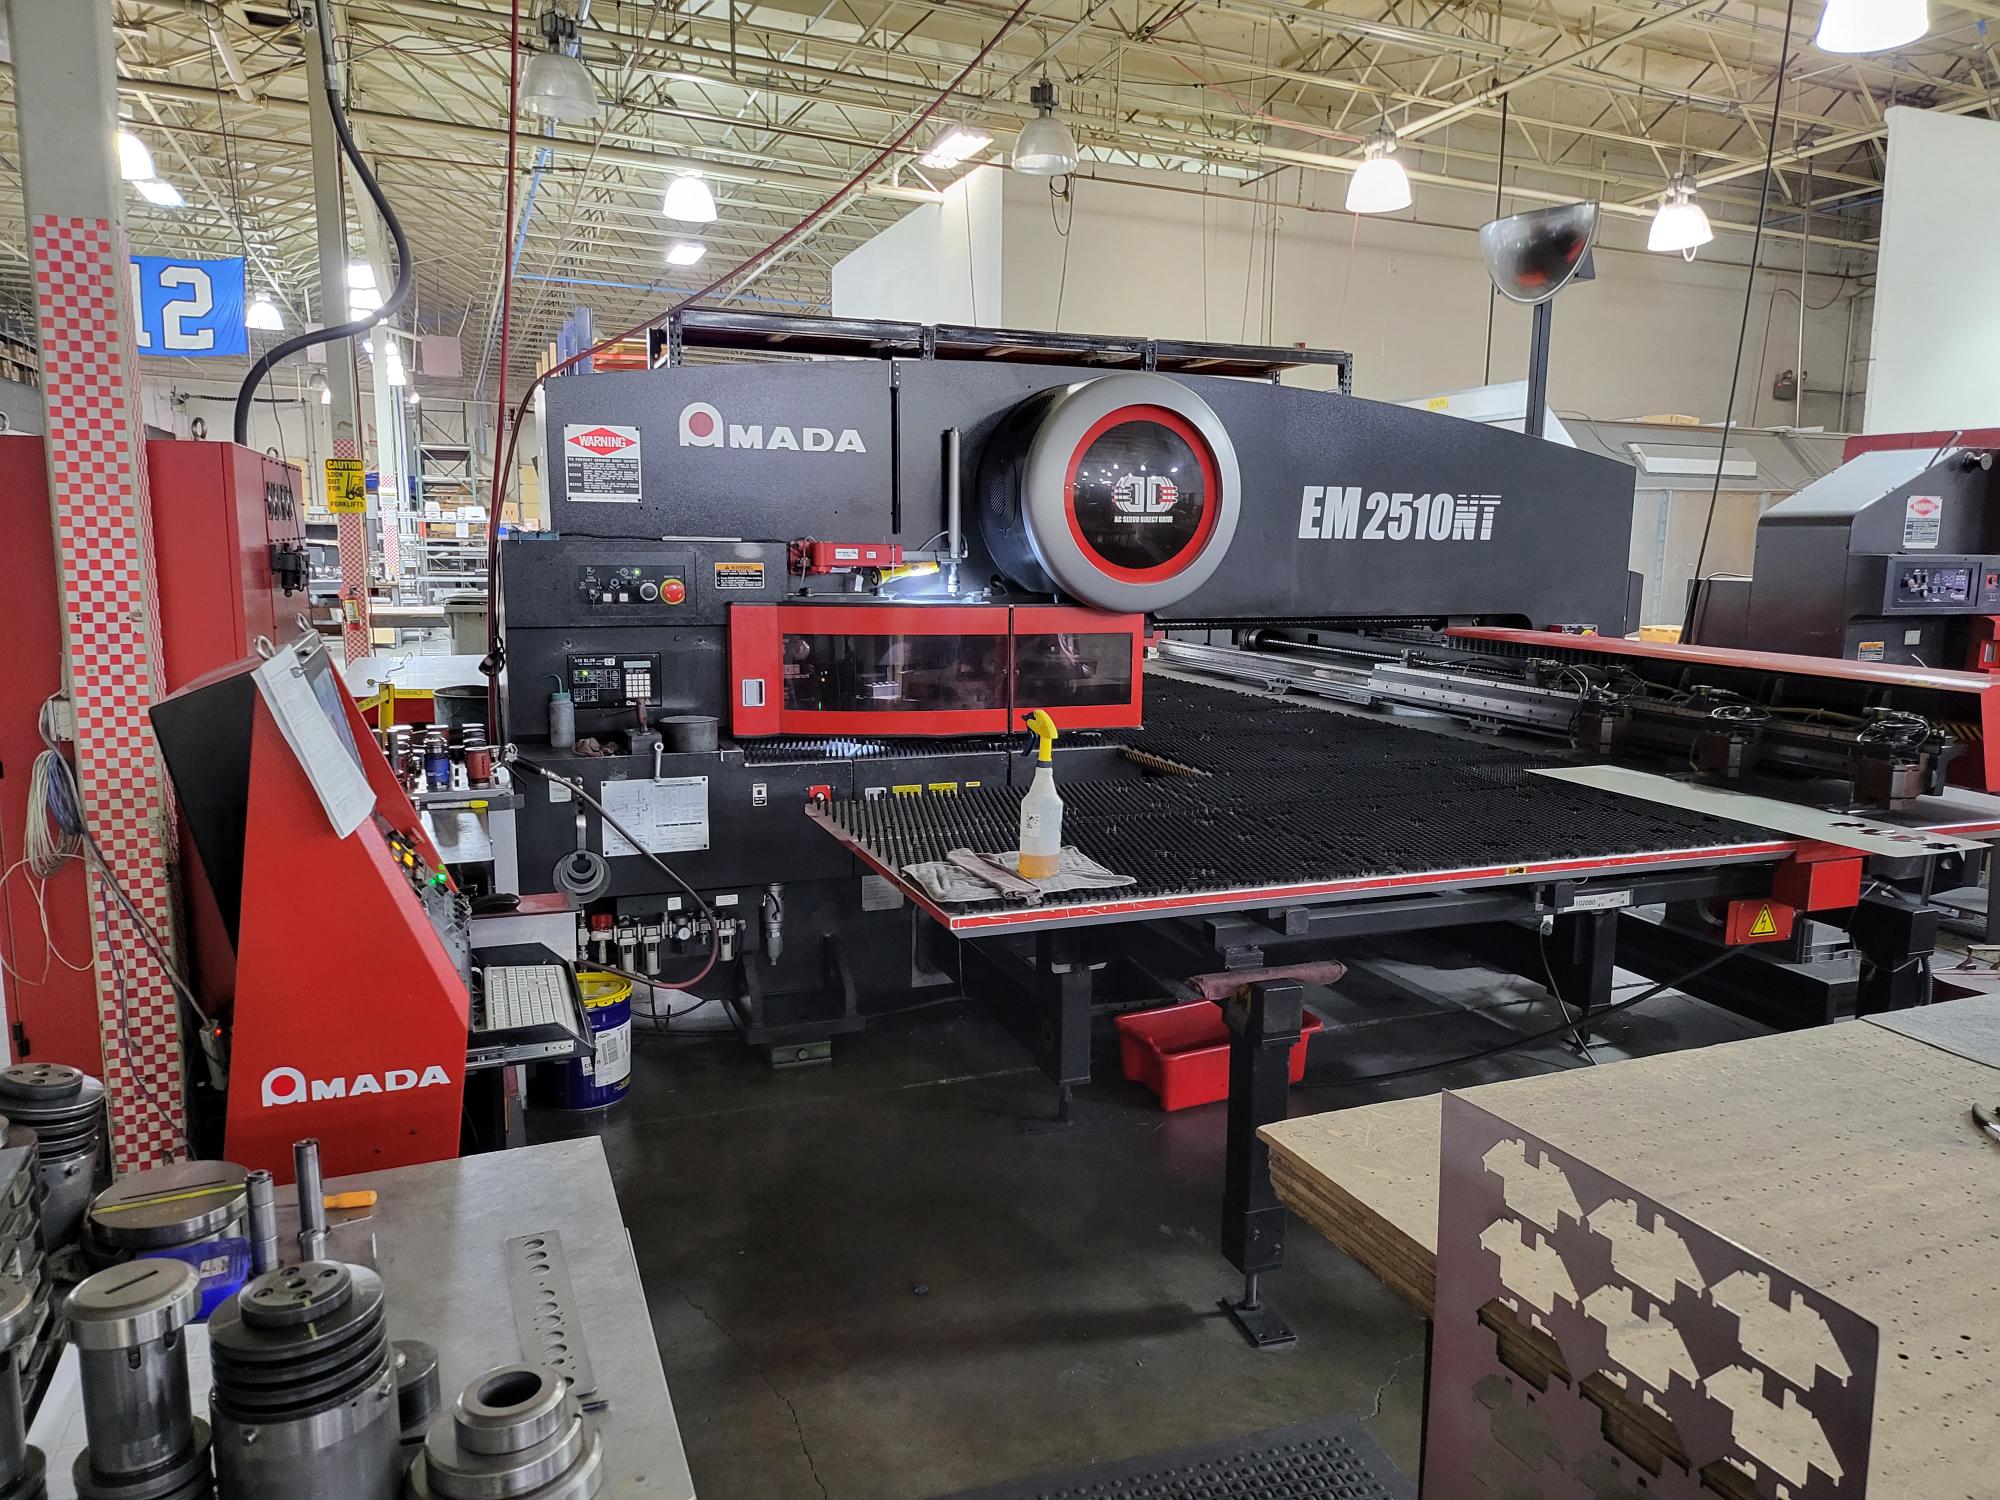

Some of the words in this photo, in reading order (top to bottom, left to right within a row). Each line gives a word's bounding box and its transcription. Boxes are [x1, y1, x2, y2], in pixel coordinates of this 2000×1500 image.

[679, 402, 867, 453] AMADA
[579, 436, 626, 447] WARNING
[327, 461, 362, 470] CAUTION
[261, 1066, 451, 1108] AMADA
